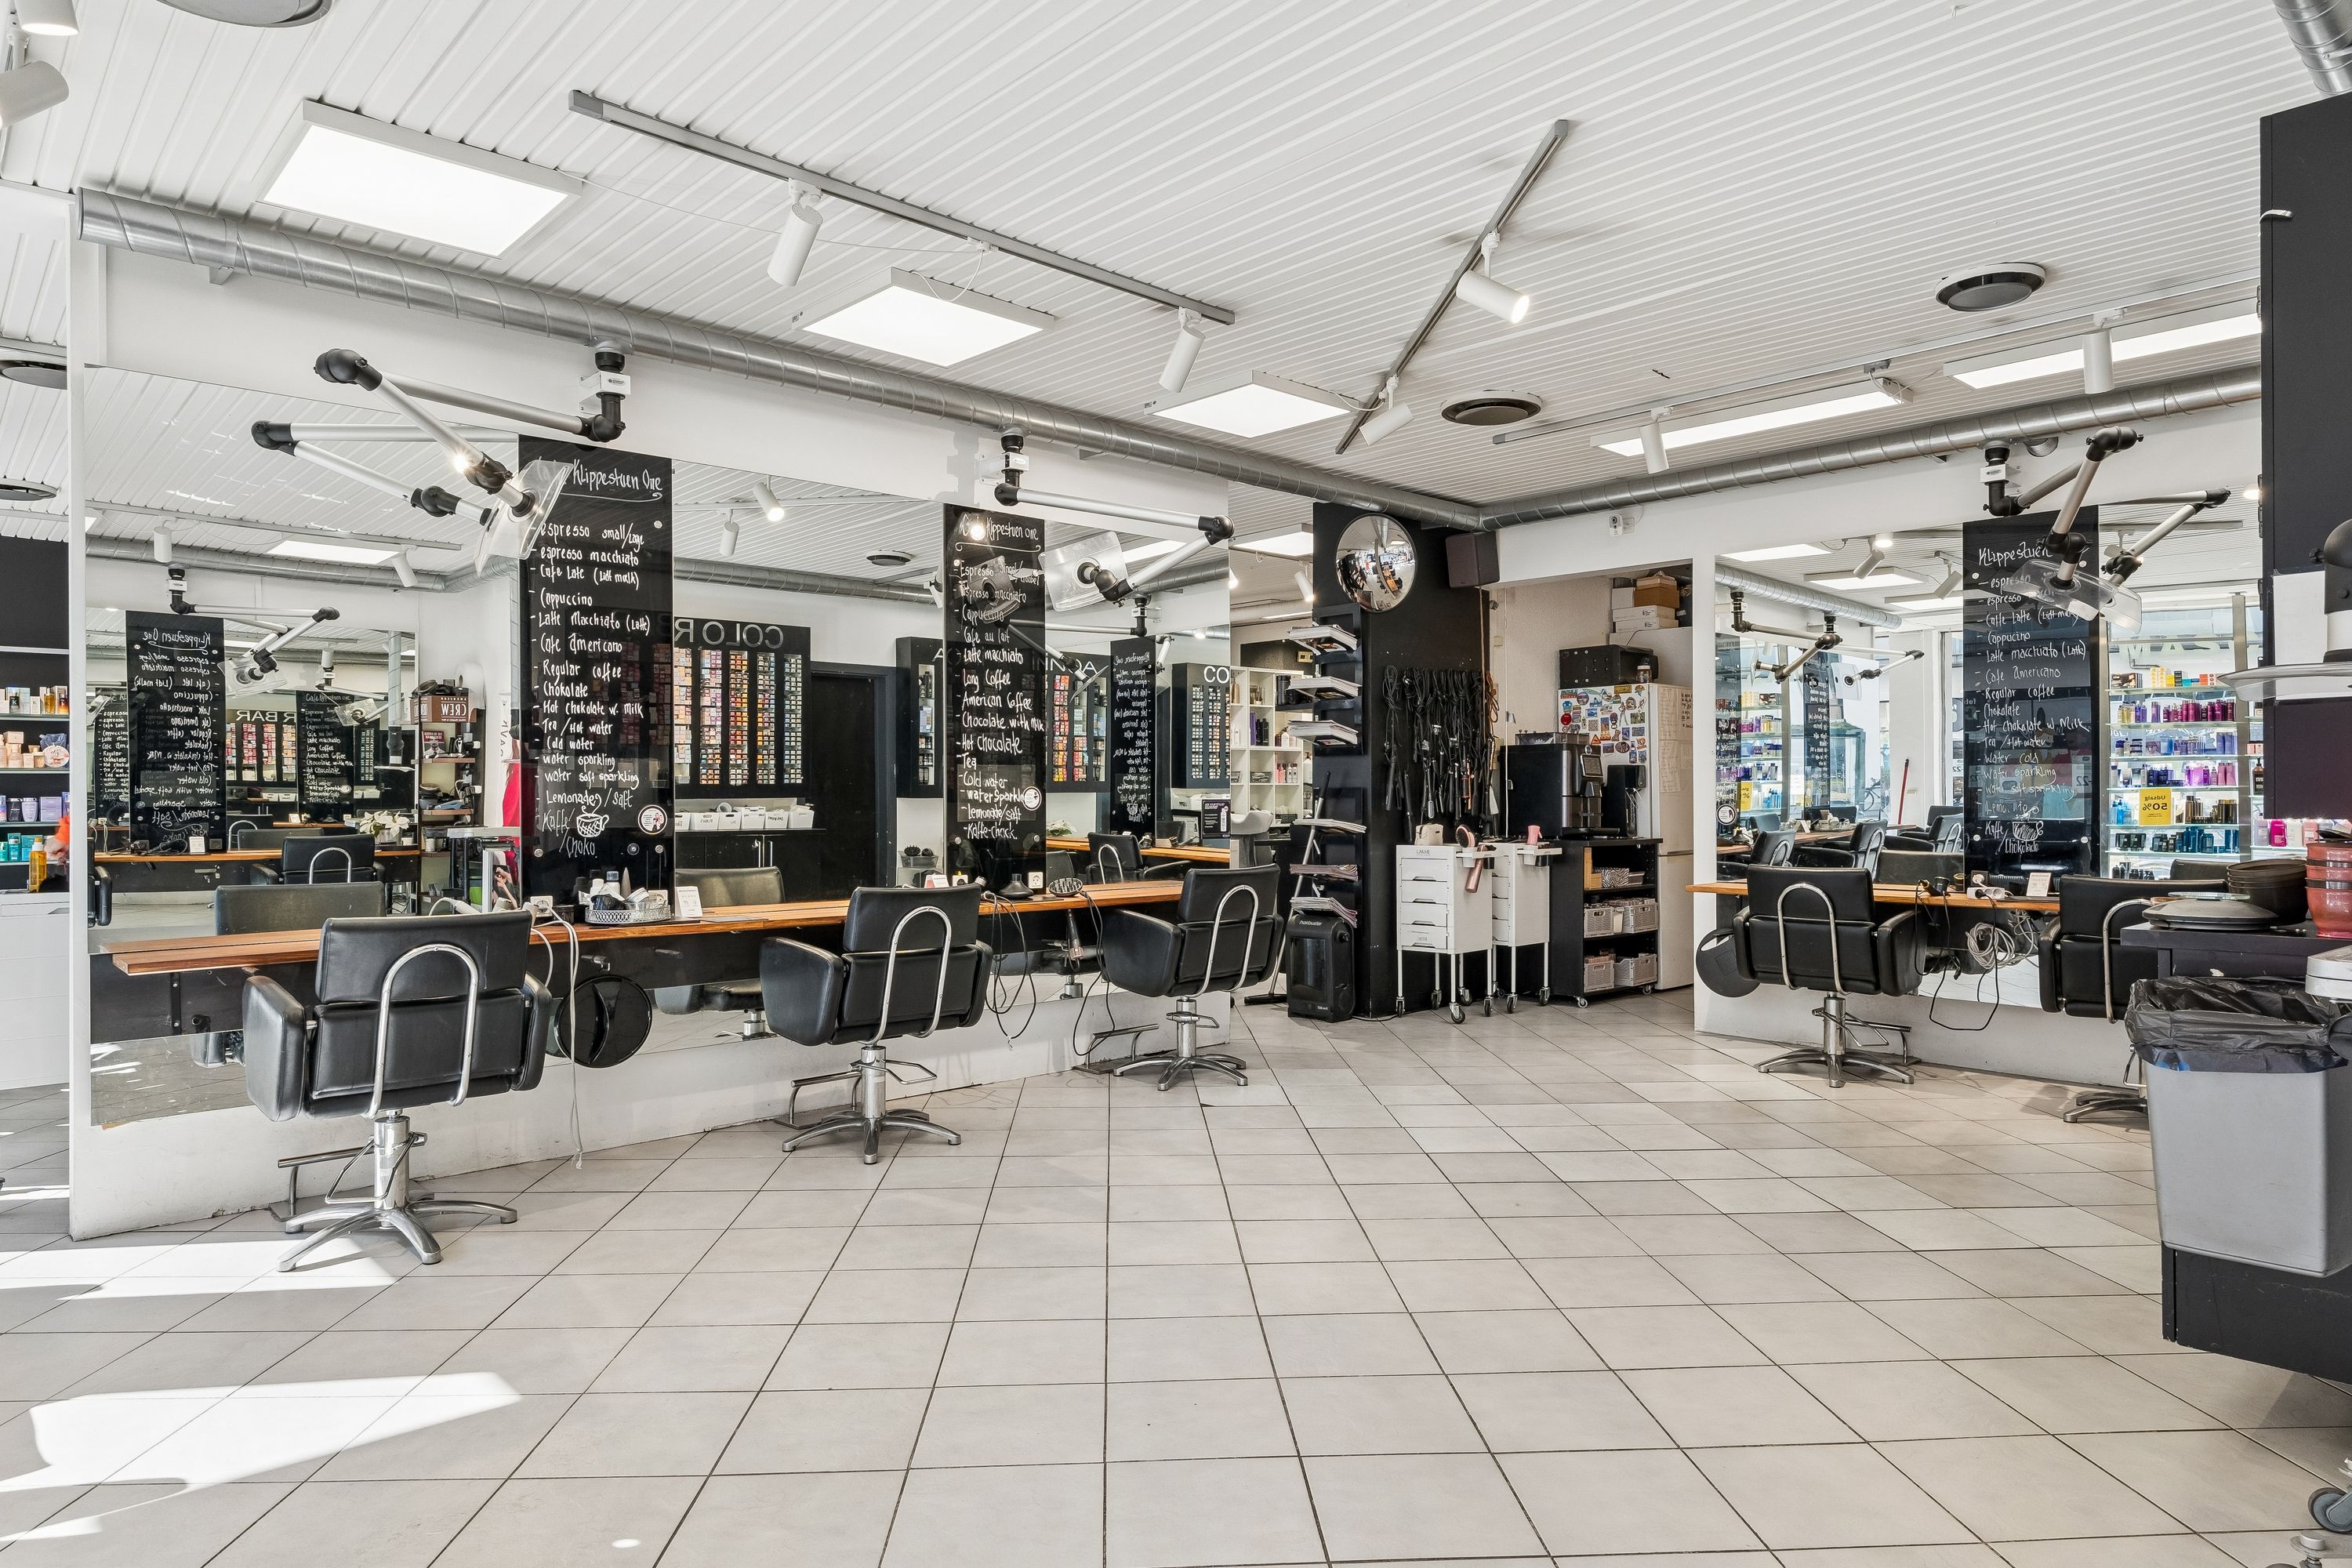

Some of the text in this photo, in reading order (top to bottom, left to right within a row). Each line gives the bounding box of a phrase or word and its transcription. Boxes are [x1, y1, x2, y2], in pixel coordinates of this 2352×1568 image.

[540, 523, 590, 543] espresso
[541, 546, 639, 567] espresso macchiato
[541, 587, 593, 609] Cappuccino
[1987, 595, 2021, 610] espresso
[539, 612, 561, 627] Latte
[2013, 610, 2031, 624] Latte
[541, 633, 561, 654] Cafe
[964, 626, 1010, 646] Cafe au lait
[964, 648, 1023, 665] Latte macchiato
[1987, 650, 2005, 662] Latte
[543, 659, 580, 685] Regular
[963, 668, 1011, 693] Long Coffee
[1986, 669, 2005, 684] Cafe
[543, 681, 588, 697] Chokolate
[1985, 688, 2016, 702] Regular
[543, 701, 558, 713] Hot
[962, 691, 1032, 713] American Coffee
[1984, 703, 2020, 720] Chokolate
[543, 719, 557, 732] Tea
[590, 722, 613, 735] water
[1009, 713, 1029, 731] with
[1983, 720, 1995, 732] Hot
[547, 738, 594, 750] Cold water
[963, 731, 1022, 756] Hot Chocolate
[1984, 737, 1995, 747] Tea
[2024, 738, 2045, 747] water
[543, 753, 615, 771] water sparkling
[961, 752, 976, 770] Tea
[544, 770, 639, 789] water soft sparkling
[964, 771, 1007, 789] Cold water
[967, 789, 993, 803] water
